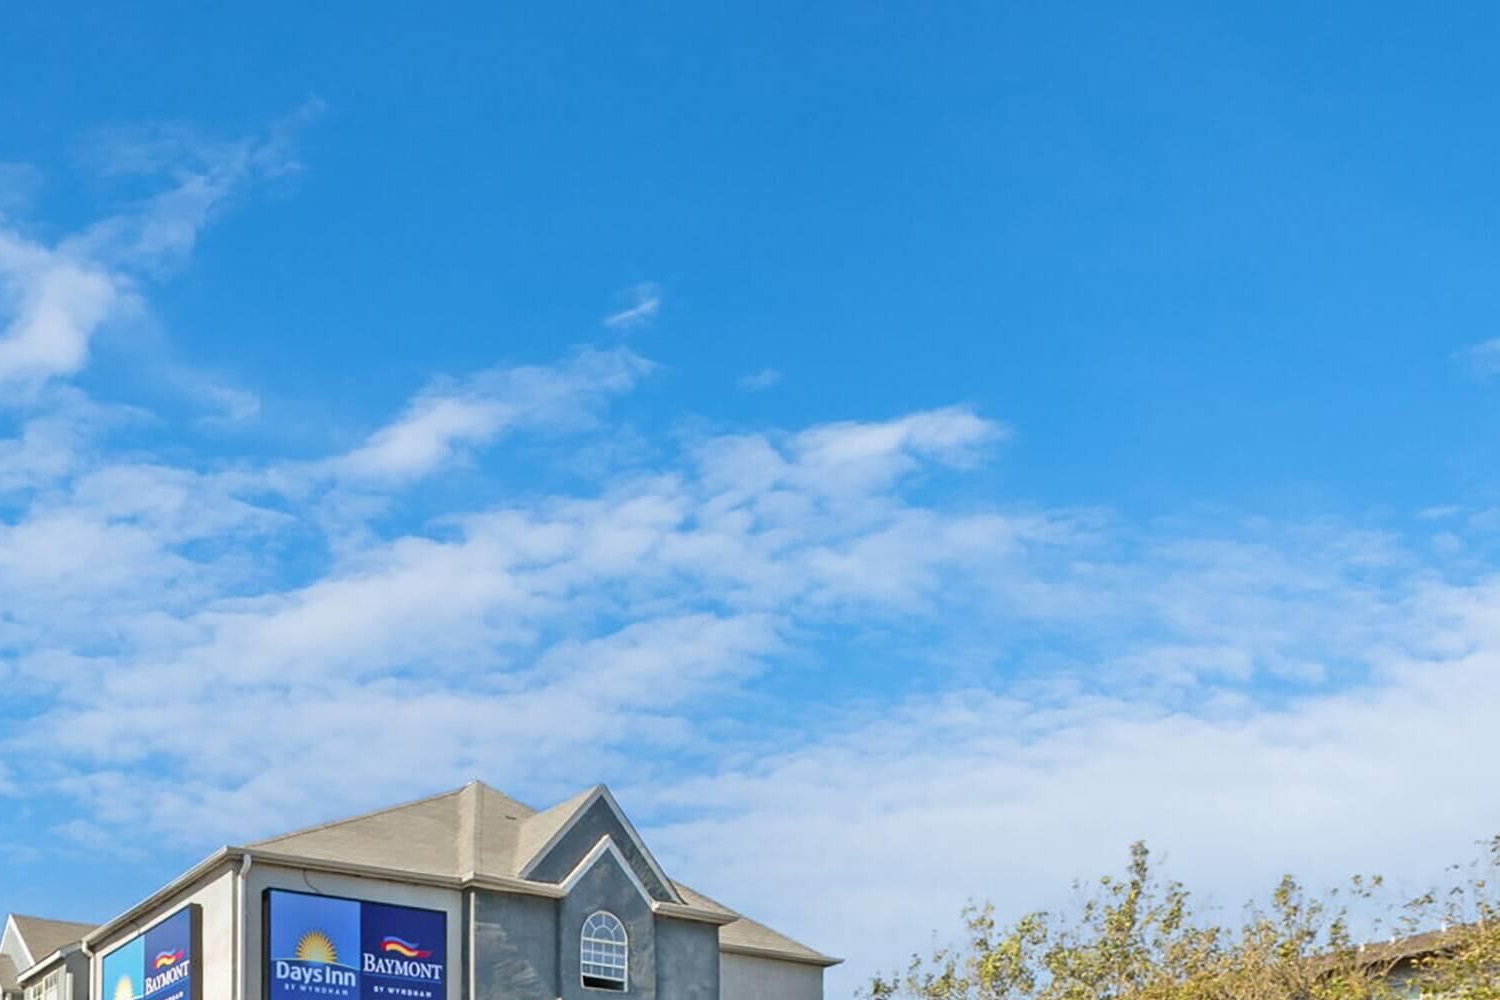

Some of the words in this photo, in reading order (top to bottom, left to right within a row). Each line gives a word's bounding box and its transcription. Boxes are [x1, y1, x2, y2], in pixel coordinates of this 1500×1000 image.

[145, 959, 190, 996] BAYMONT
[276, 960, 323, 984] Days
[325, 966, 356, 987] Inn
[363, 952, 443, 980] BAYMONT
